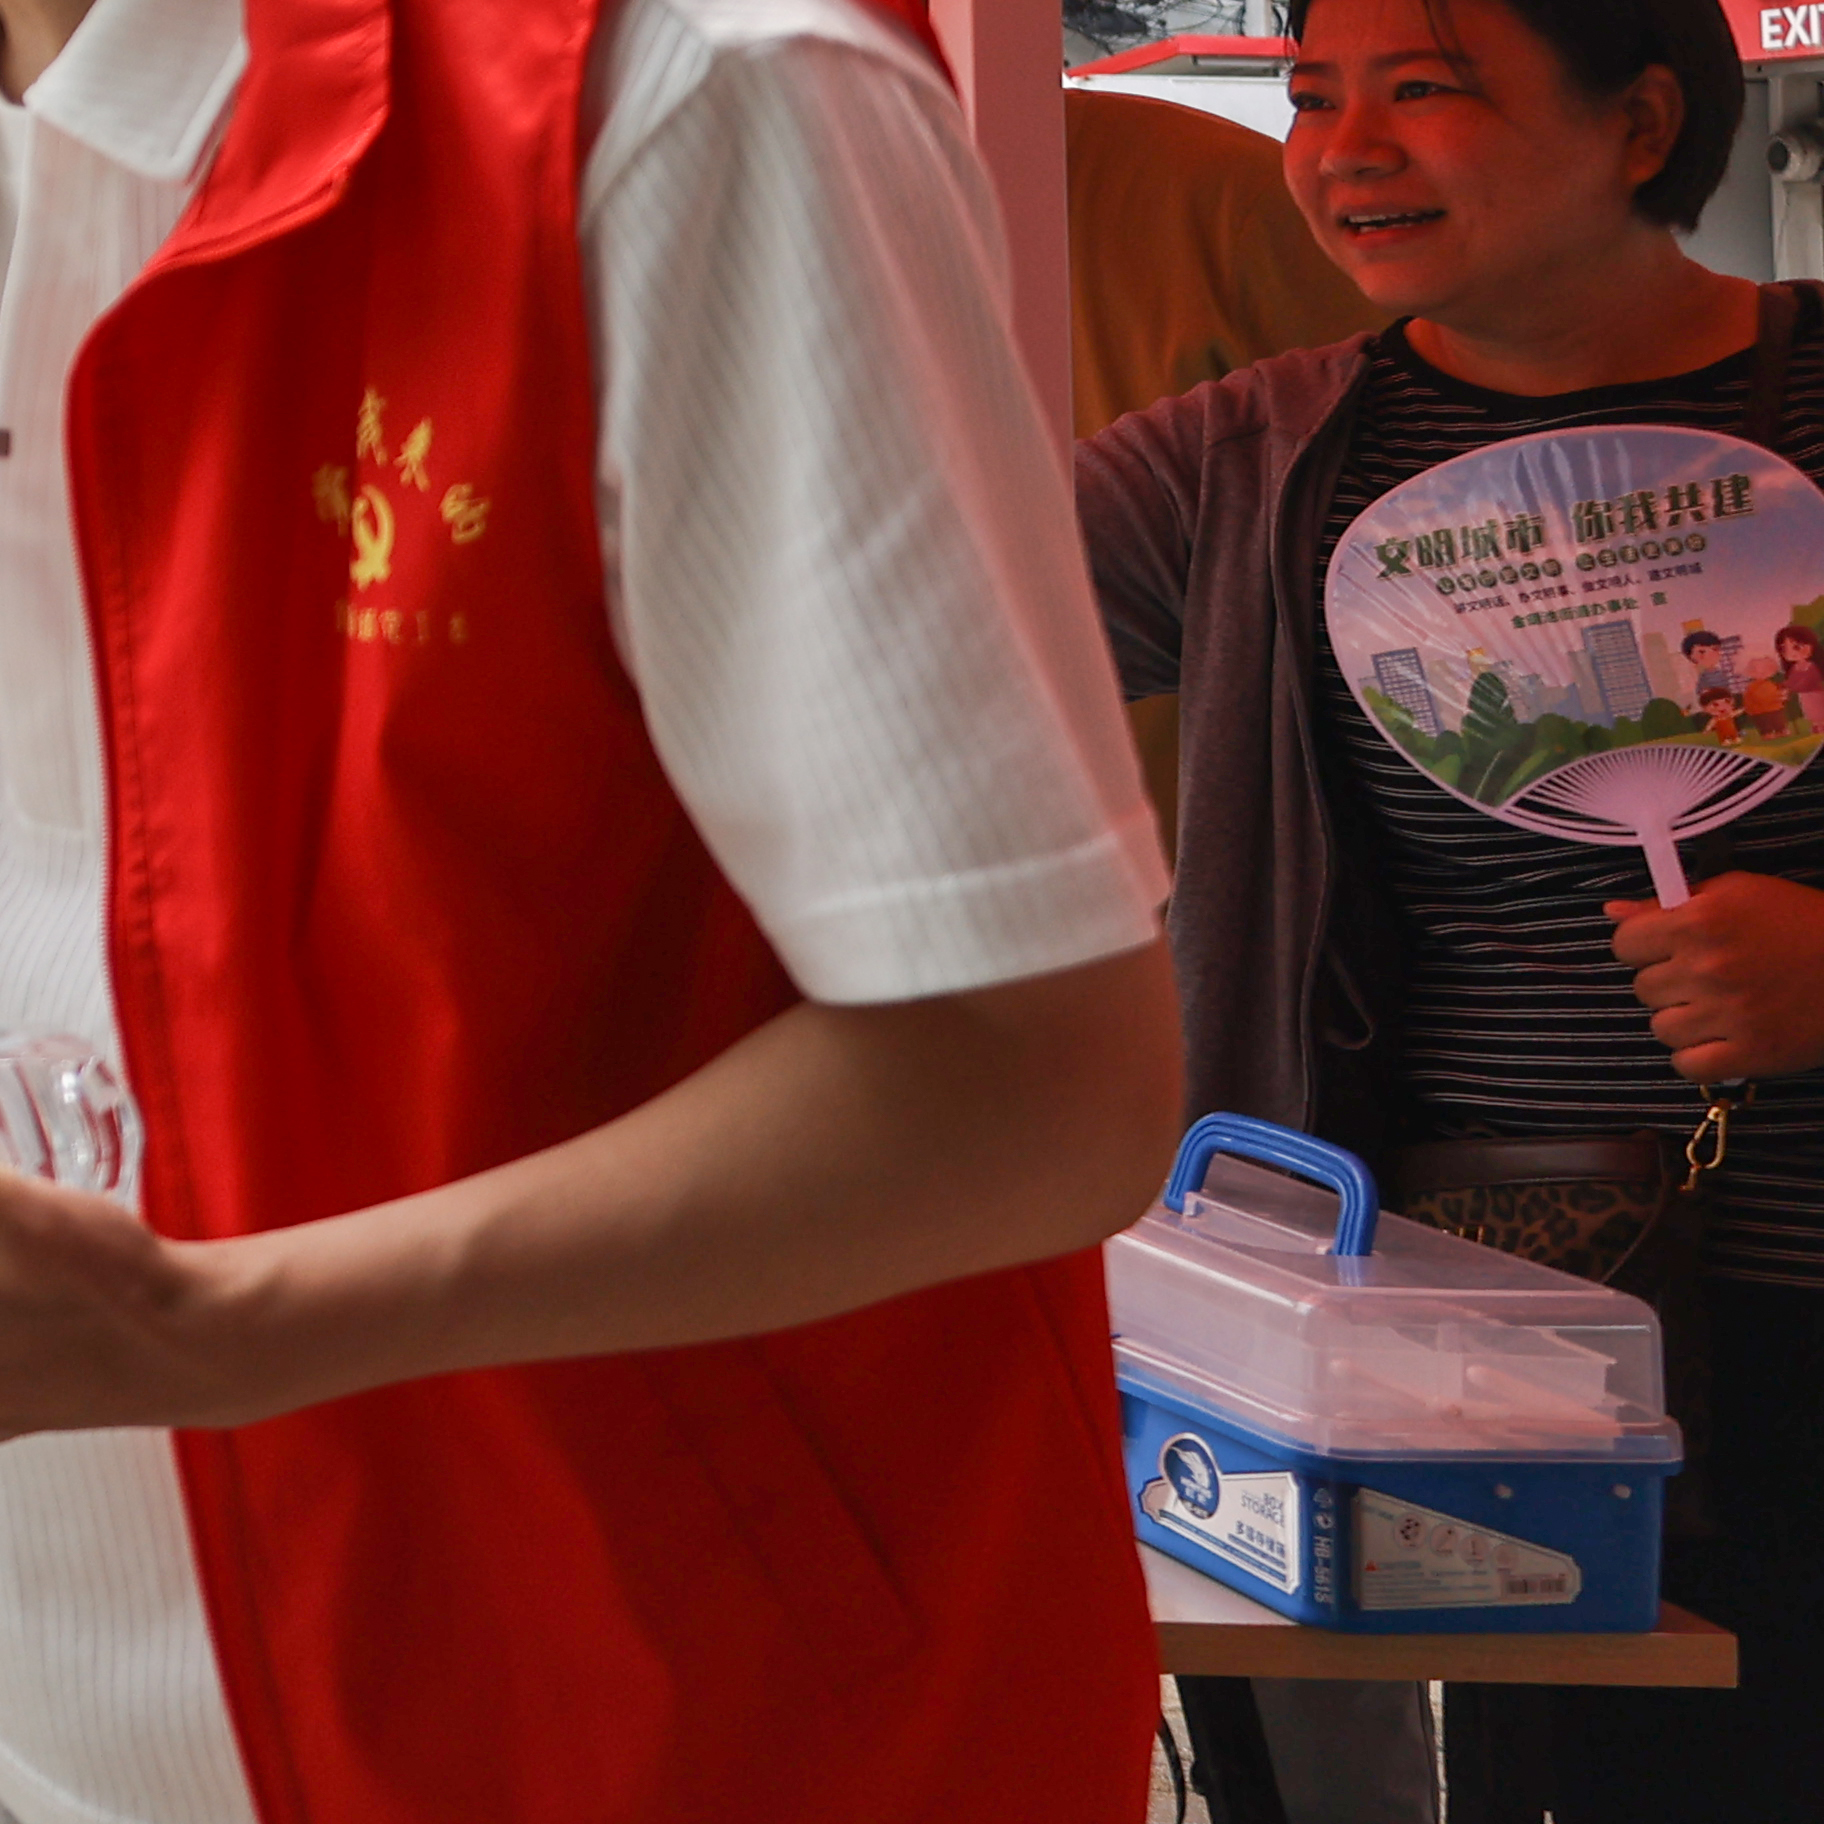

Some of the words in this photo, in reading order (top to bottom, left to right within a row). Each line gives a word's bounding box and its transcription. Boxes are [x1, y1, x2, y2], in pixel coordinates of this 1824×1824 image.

[1761, 3, 1824, 50] EXI
[1374, 513, 1545, 578] 文明城市
[1571, 473, 1755, 544] 你我共建
